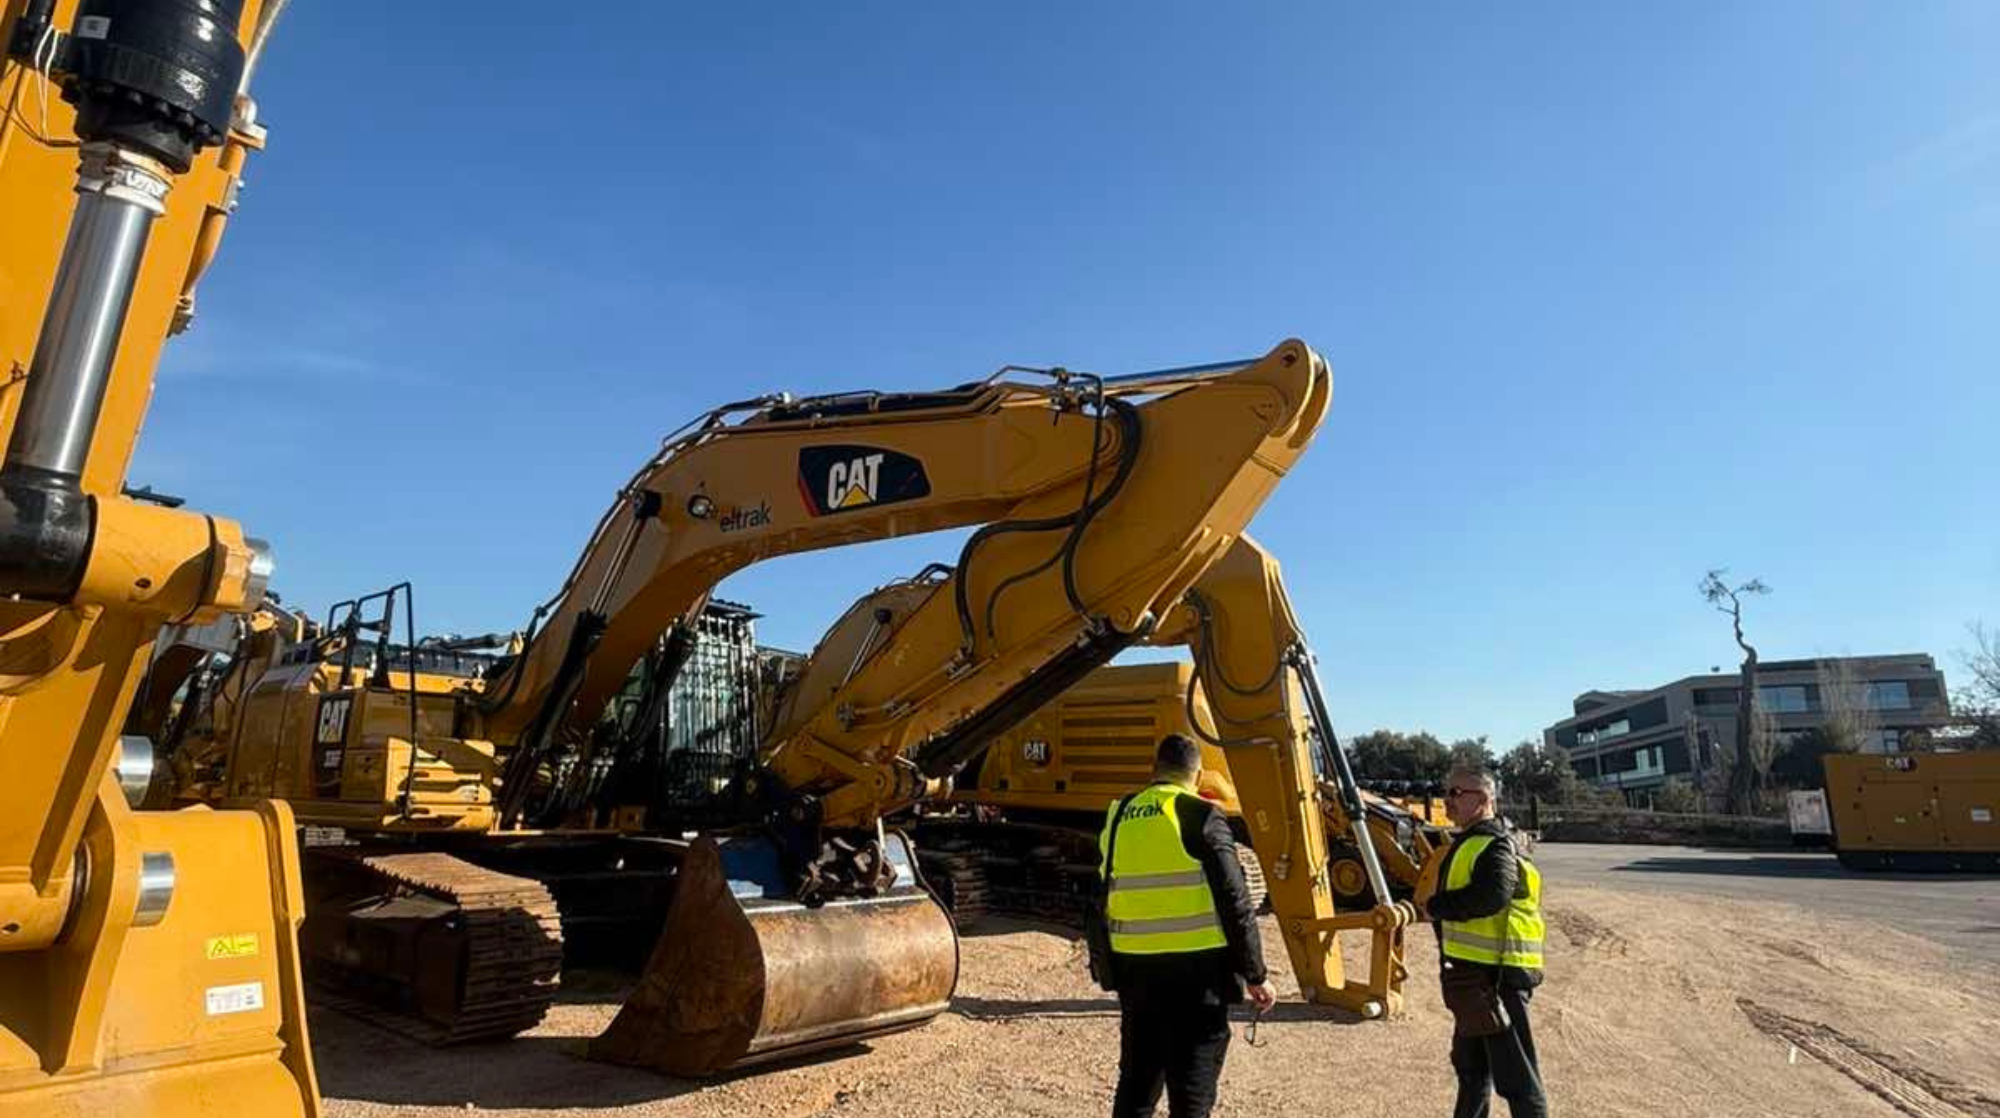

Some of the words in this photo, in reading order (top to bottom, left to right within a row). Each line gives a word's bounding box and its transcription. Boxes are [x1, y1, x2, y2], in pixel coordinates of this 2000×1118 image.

[827, 454, 884, 510] CAT
[720, 502, 771, 532] eltrak
[318, 700, 350, 742] CAT
[1024, 742, 1046, 760] CAT
[1122, 799, 1165, 821] ltrak
